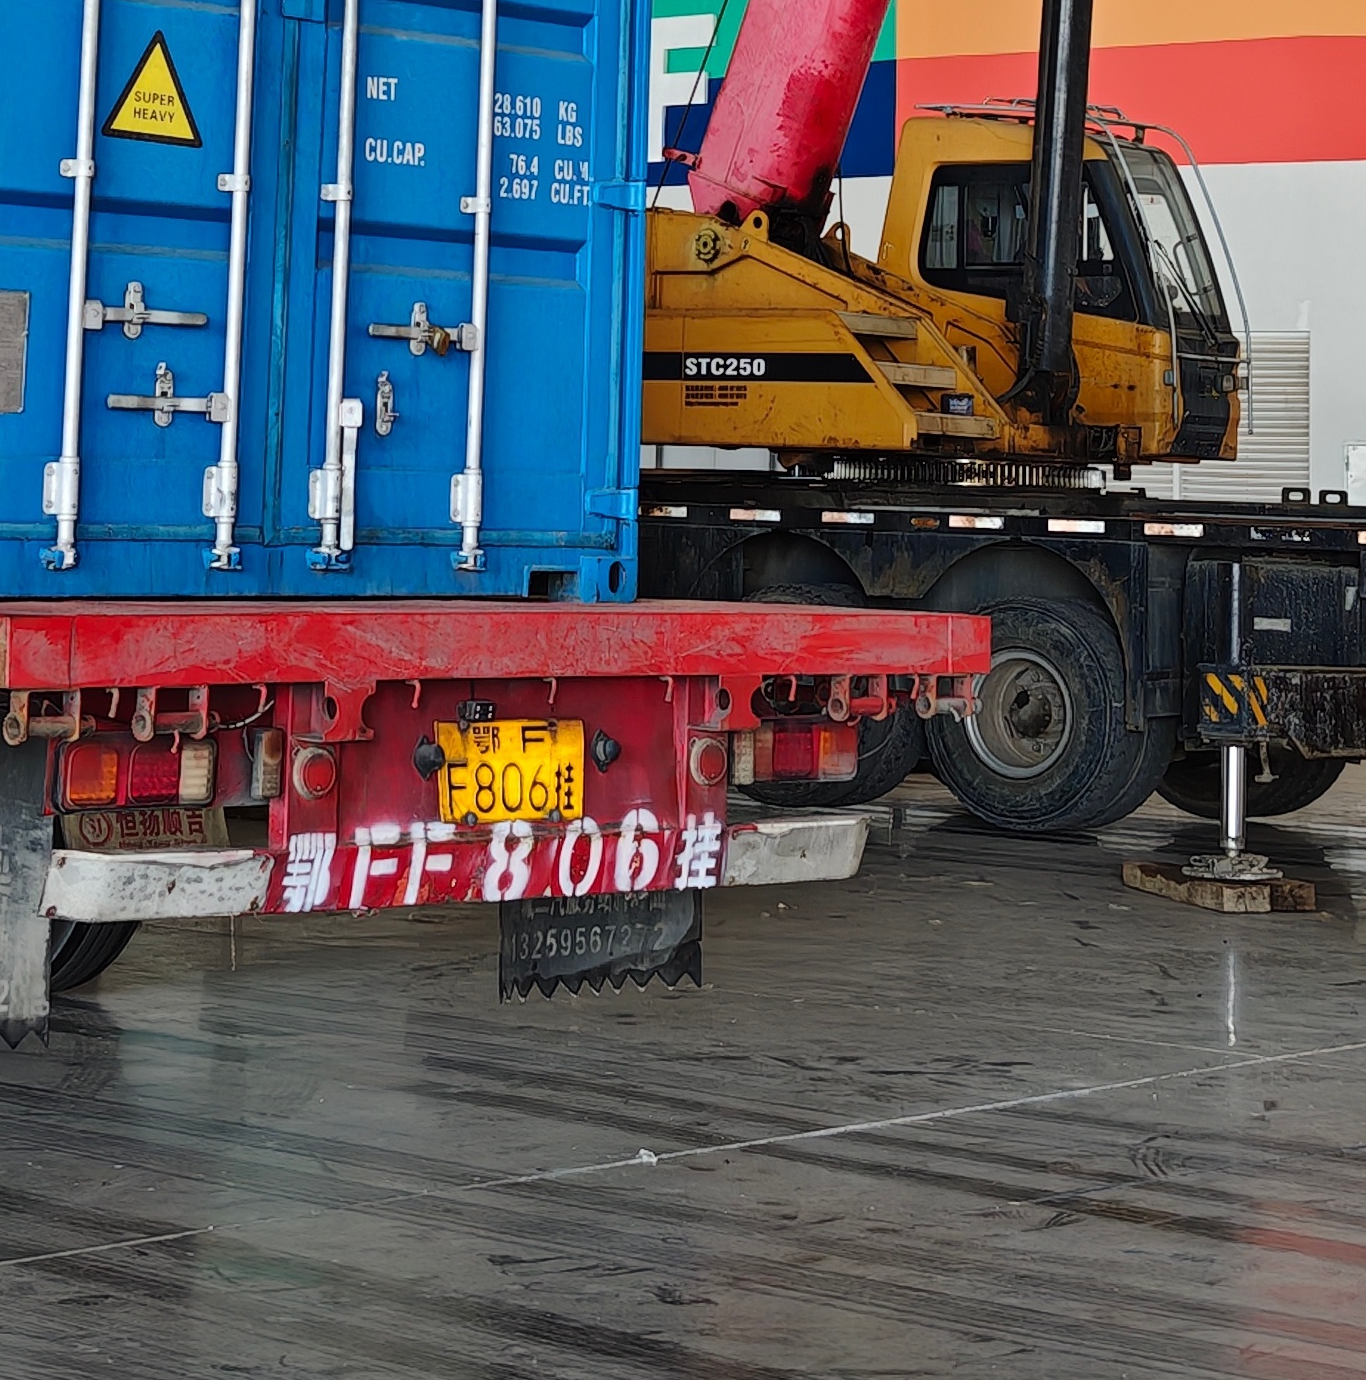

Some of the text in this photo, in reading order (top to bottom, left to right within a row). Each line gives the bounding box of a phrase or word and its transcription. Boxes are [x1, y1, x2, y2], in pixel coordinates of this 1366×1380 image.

[134, 90, 175, 107] SUPER
[367, 77, 577, 122] NET 28.610 KG
[133, 107, 176, 123] HEAVY
[494, 117, 583, 148] 63.075 LBS
[365, 138, 425, 167] CU.CAP.
[509, 154, 539, 176] 76.4
[499, 178, 538, 200] 2.697
[684, 357, 766, 376] STC250
[447, 761, 575, 817] F806挂
[116, 808, 205, 839] 恒扬顺吉
[511, 923, 671, 962] 13259567272
